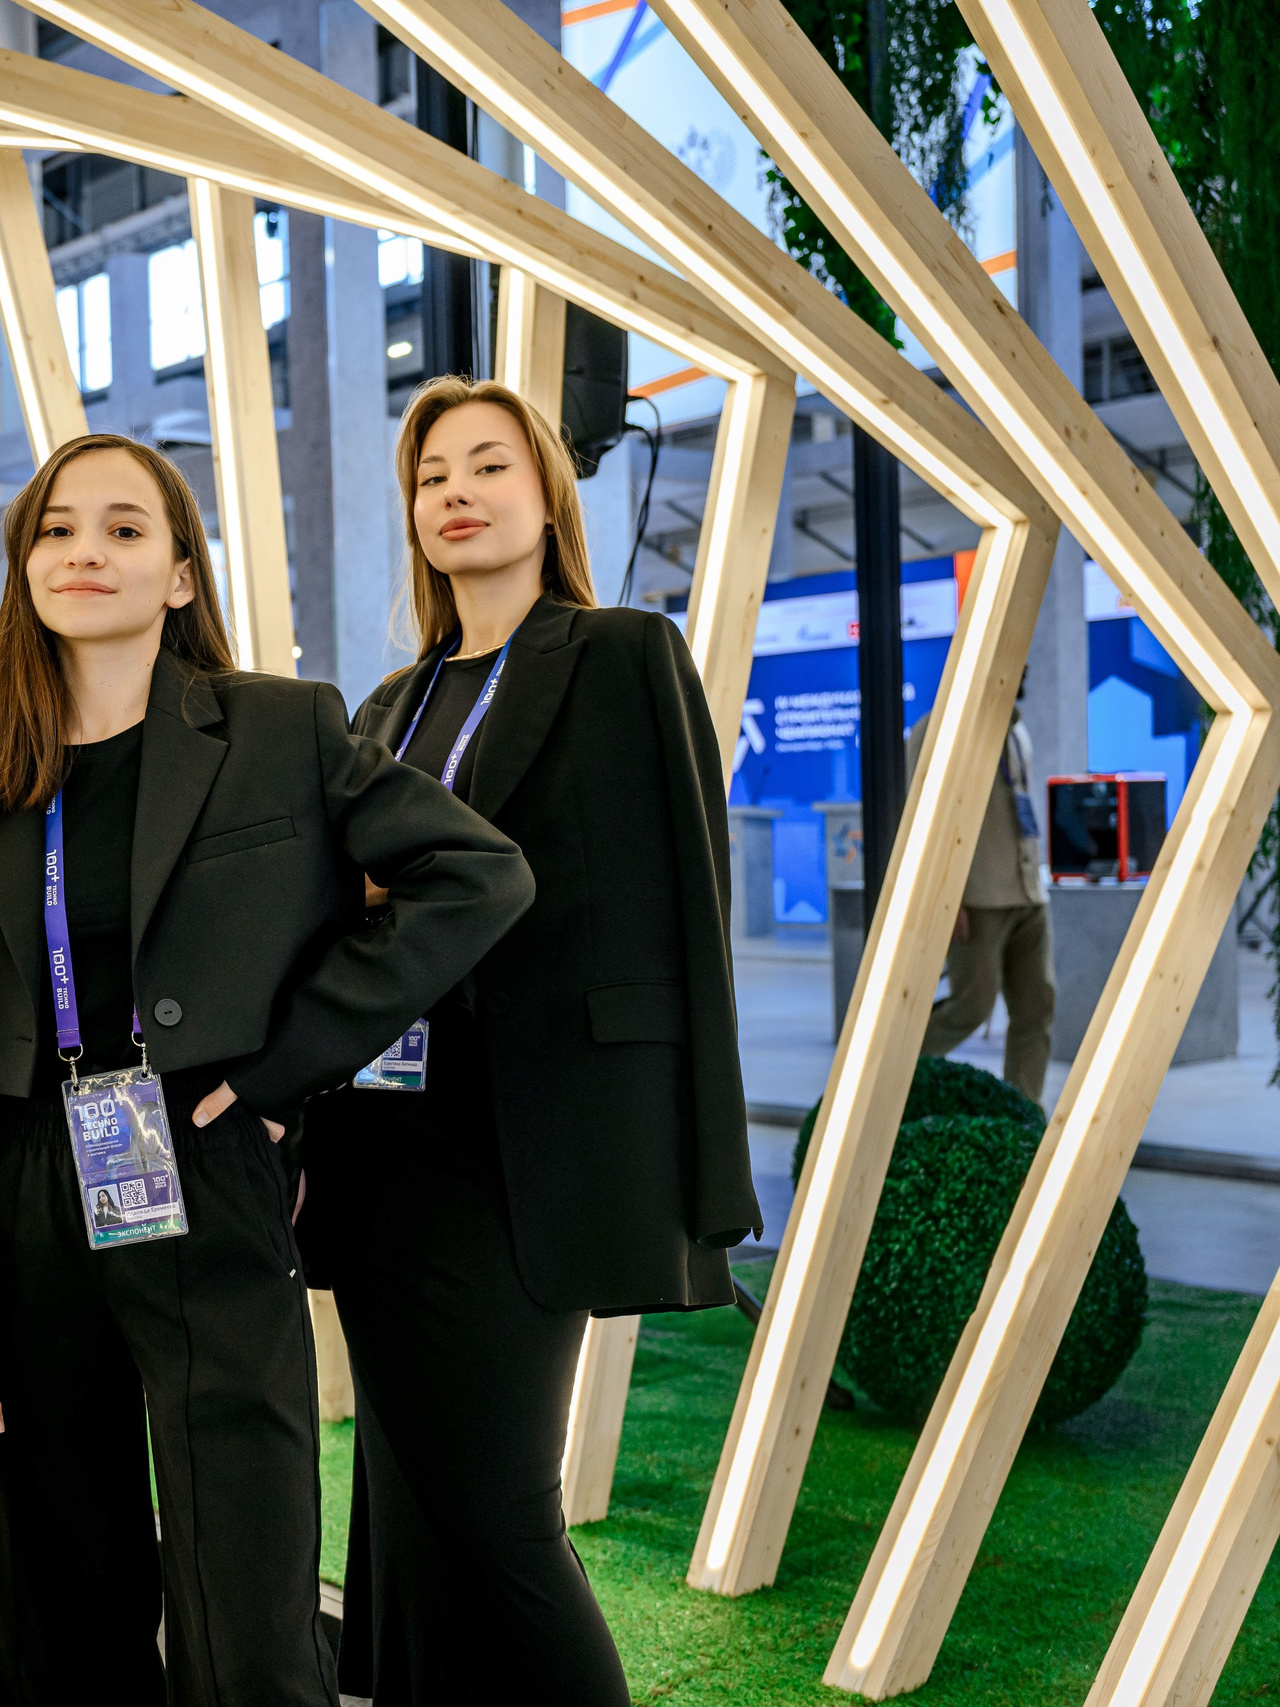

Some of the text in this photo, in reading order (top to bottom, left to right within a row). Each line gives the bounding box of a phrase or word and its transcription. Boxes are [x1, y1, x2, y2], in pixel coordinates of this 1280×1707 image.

[444, 753, 457, 785] 100+
[46, 849, 60, 882] 100+
[52, 947, 70, 984] 100+
[56, 988, 64, 1010] BUILD
[74, 1092, 127, 1122] 100+
[81, 1117, 118, 1131] TECHNO
[82, 1126, 120, 1142] BUILD
[117, 1225, 157, 1238] ЭКСПОНЕНТ
